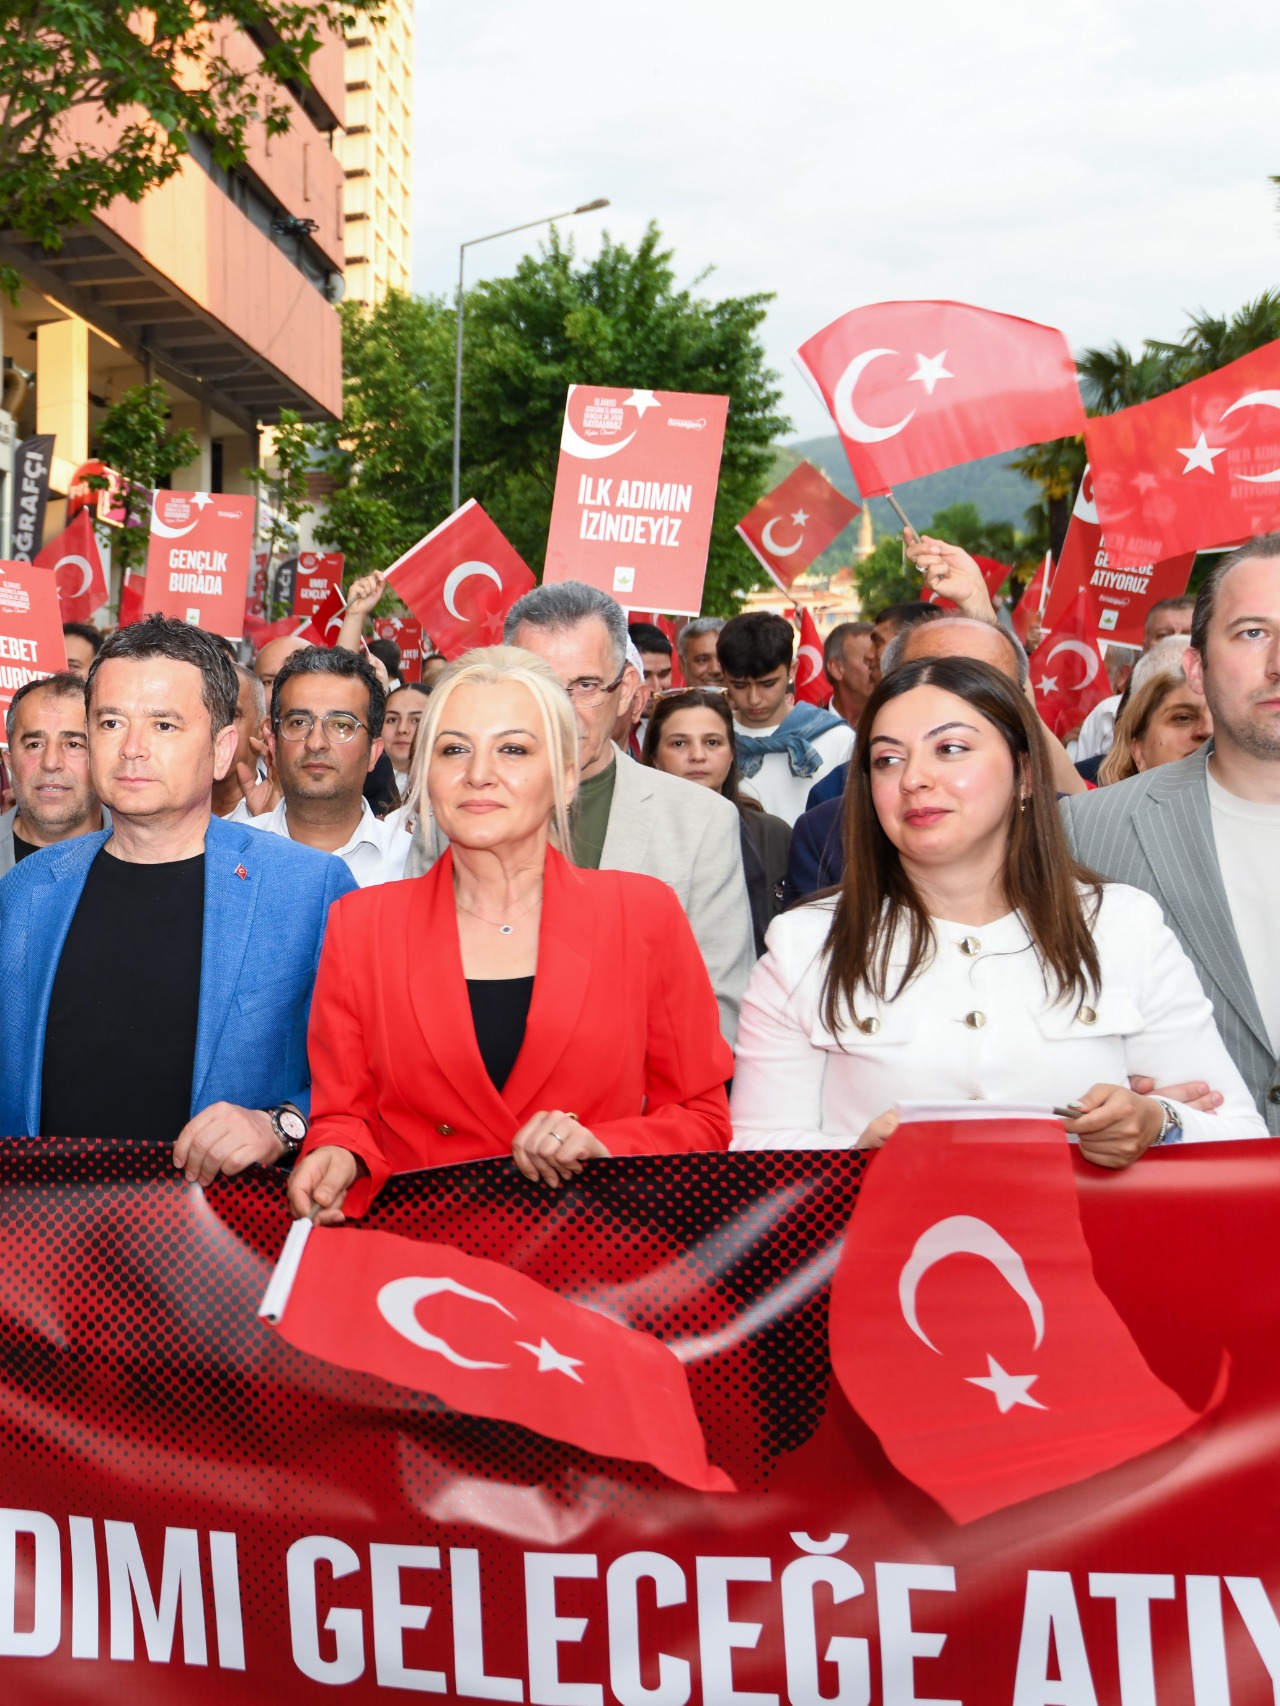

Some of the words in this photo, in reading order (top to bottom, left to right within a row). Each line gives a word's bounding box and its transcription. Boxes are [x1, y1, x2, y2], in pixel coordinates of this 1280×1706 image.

[578, 474, 614, 507] İLK
[615, 480, 693, 513] ADIMIN
[579, 509, 683, 547] İZİNDEYİZ
[169, 548, 228, 574] GENÇLİK
[169, 572, 223, 595] BURADA
[1089, 569, 1150, 595] ATIYORUZ
[286, 1531, 963, 1706] GELECEĞE
